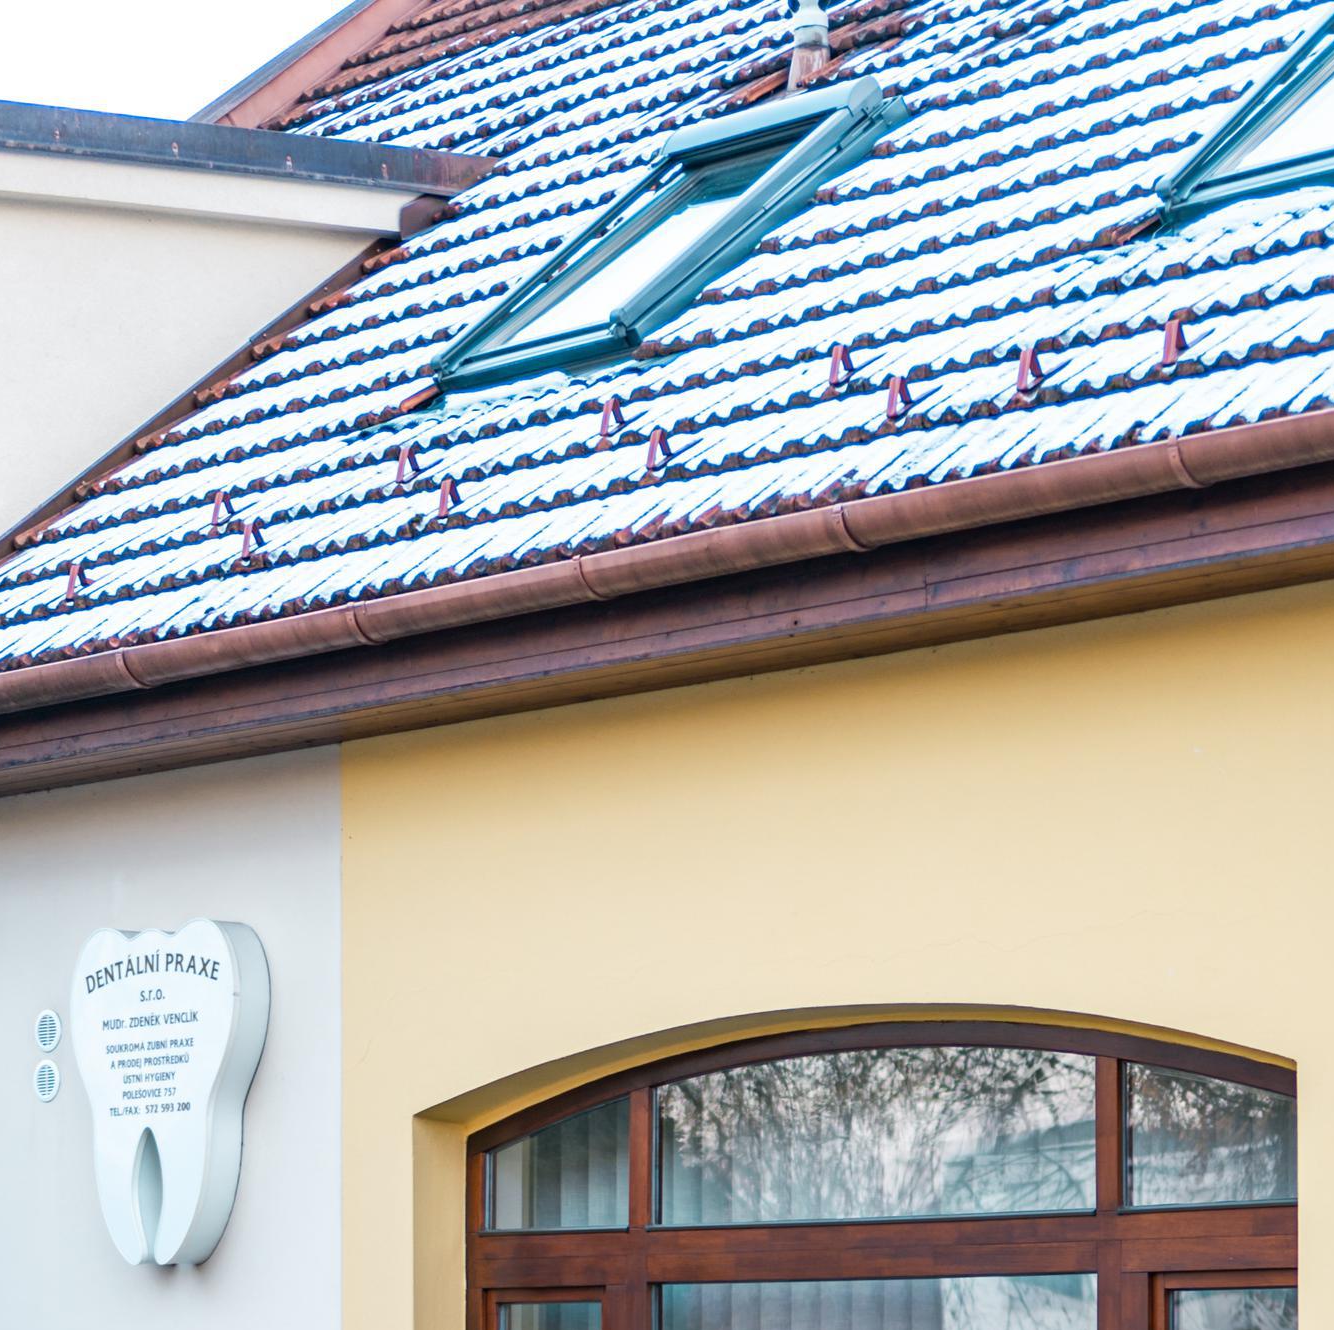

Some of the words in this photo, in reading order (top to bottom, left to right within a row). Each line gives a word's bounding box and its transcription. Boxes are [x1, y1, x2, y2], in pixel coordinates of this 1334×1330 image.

[85, 949, 160, 994] DENTÁLNÍ
[165, 952, 220, 981] PRAXE
[169, 1037, 194, 1049] PRAXE
[110, 1060, 116, 1070] A
[117, 1058, 142, 1069] PRODEJ
[144, 1071, 176, 1083] HYGIENY
[163, 1086, 177, 1097] 757
[145, 1104, 159, 1114] 572
[161, 1102, 174, 1113] 593
[176, 1101, 191, 1112] 200
